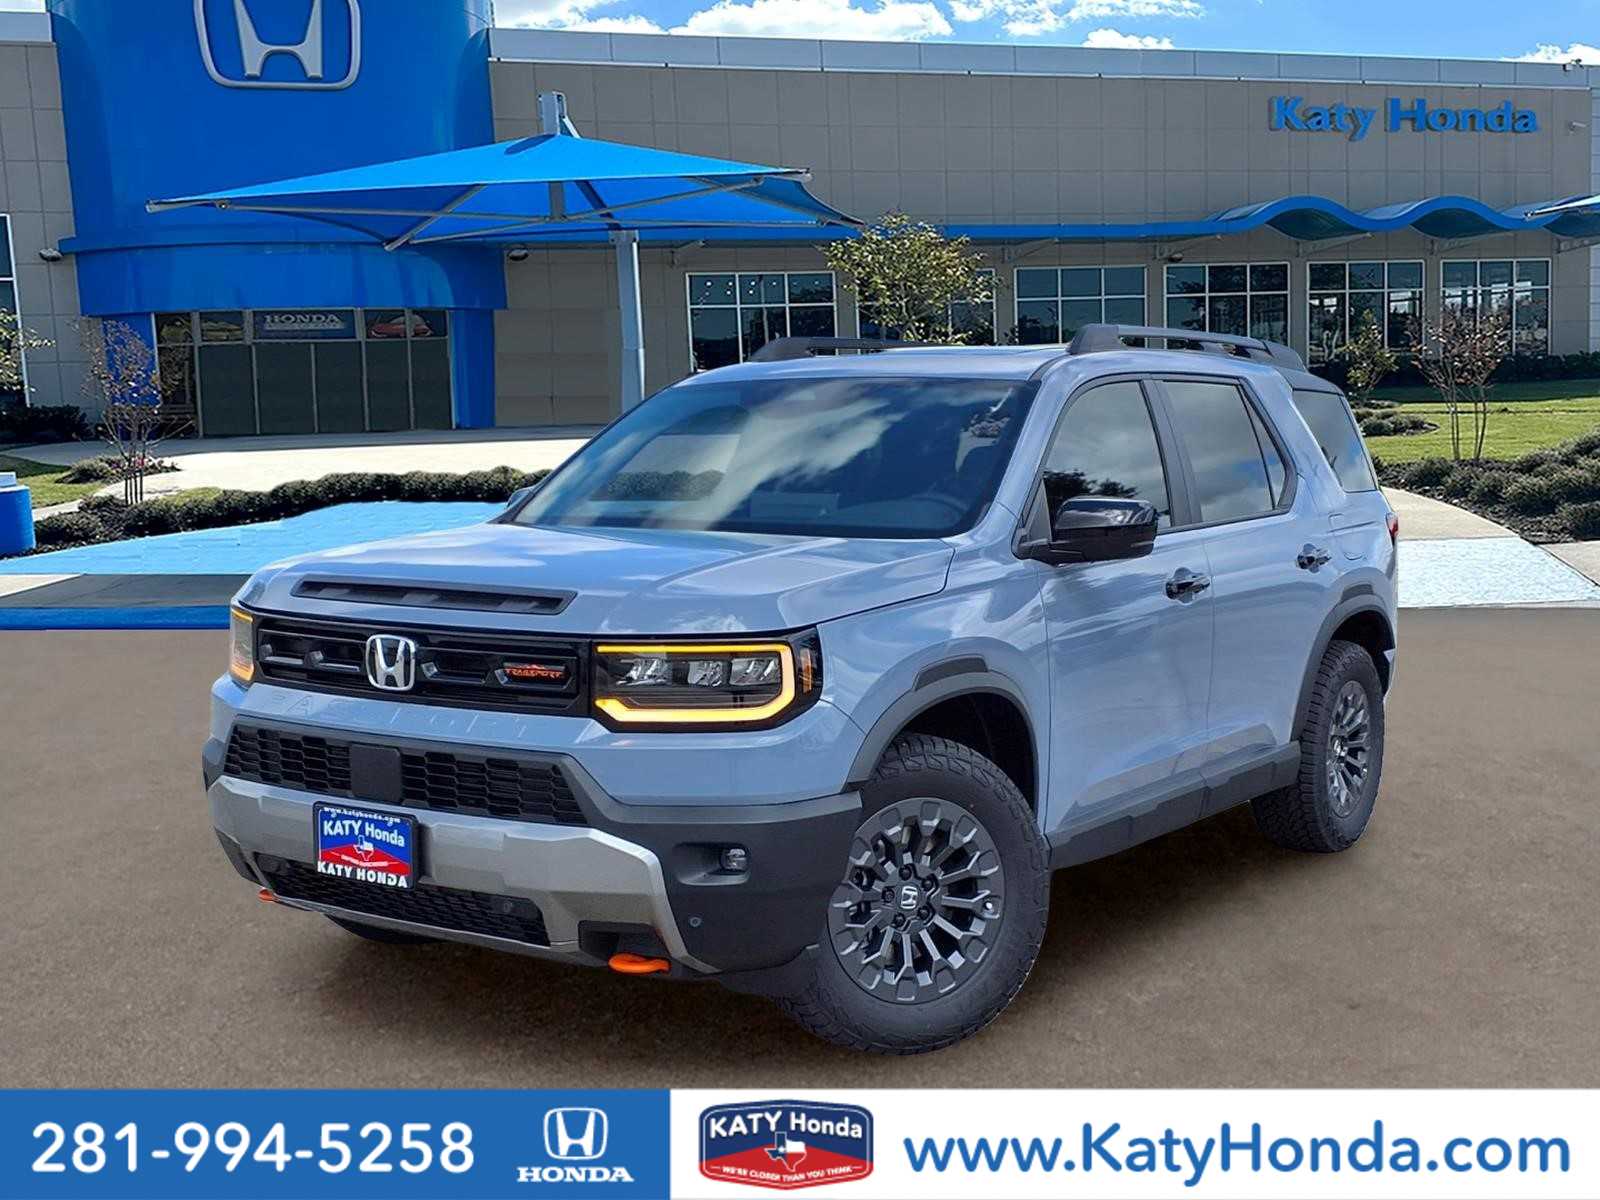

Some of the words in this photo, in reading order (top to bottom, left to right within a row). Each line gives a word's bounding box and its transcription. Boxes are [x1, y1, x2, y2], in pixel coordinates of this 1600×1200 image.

[1270, 95, 1377, 142] Katy
[1385, 97, 1540, 133] Honda
[323, 819, 362, 836] KATY
[364, 821, 406, 848] Honda
[317, 860, 353, 879] KATY
[356, 867, 408, 889] HONDA
